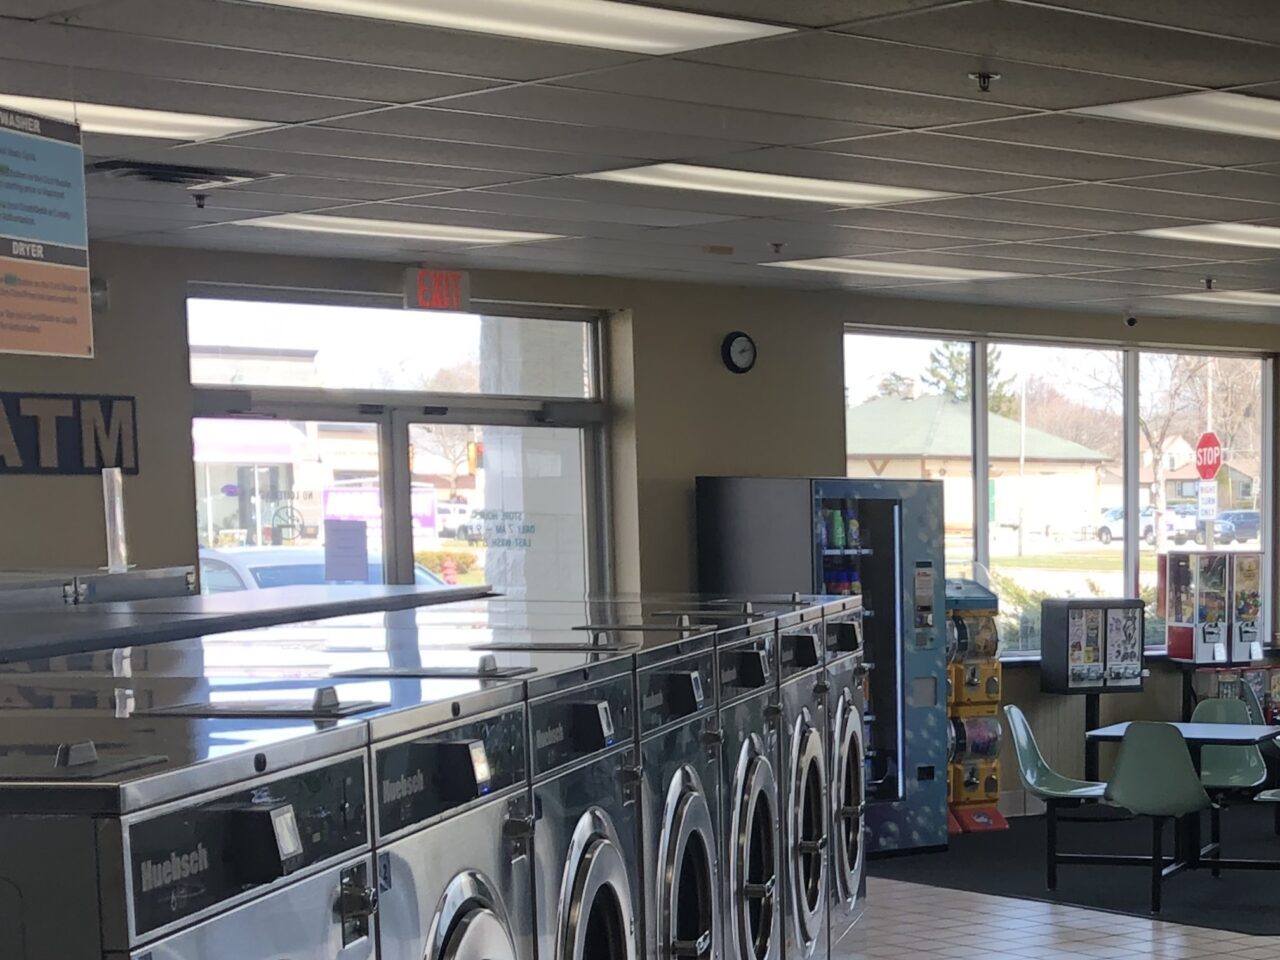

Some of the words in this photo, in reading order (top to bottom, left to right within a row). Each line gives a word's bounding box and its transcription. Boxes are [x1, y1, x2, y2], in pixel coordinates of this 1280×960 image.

[0, 110, 41, 134] WASHER
[12, 241, 44, 258] DRYER
[417, 271, 461, 309] EXIT
[1197, 446, 1220, 466] STOP
[382, 768, 424, 804] Huebsch
[140, 842, 209, 893] Huebsch
